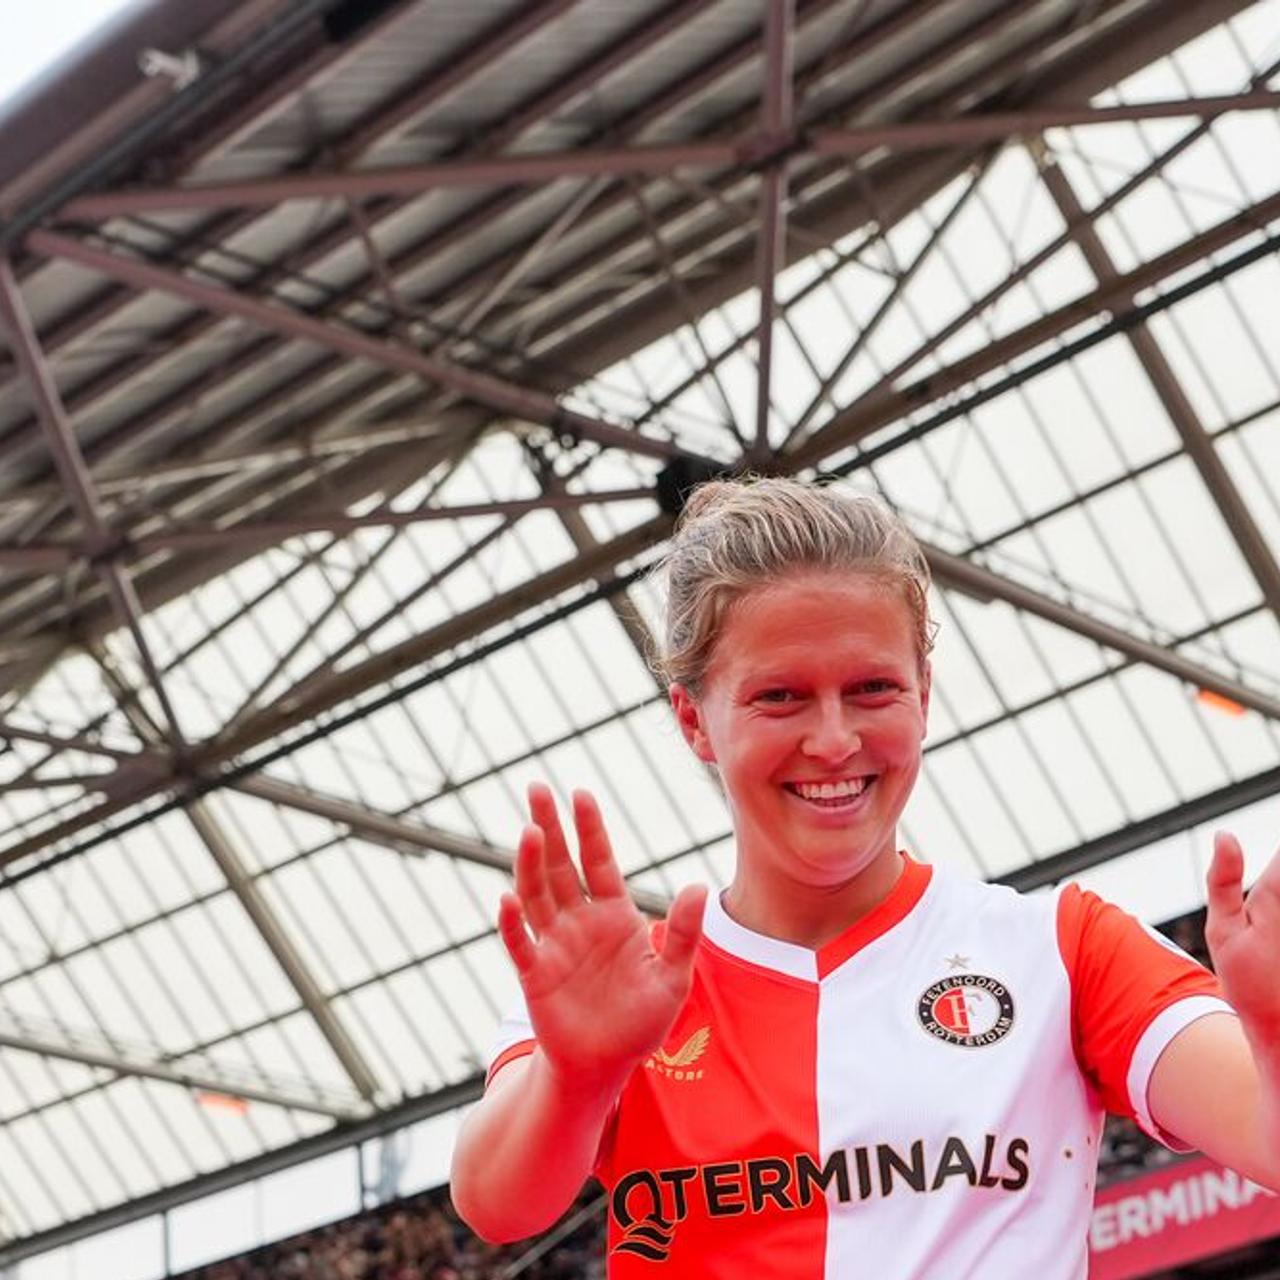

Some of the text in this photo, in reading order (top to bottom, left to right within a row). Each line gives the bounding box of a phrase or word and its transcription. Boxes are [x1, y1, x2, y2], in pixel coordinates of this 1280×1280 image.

[923, 975, 1005, 1006] FEYENOORD
[925, 1016, 1013, 1047] ROTTERDAM
[645, 1058, 704, 1081] ASTORE
[610, 1133, 1031, 1262] QTERMINALS
